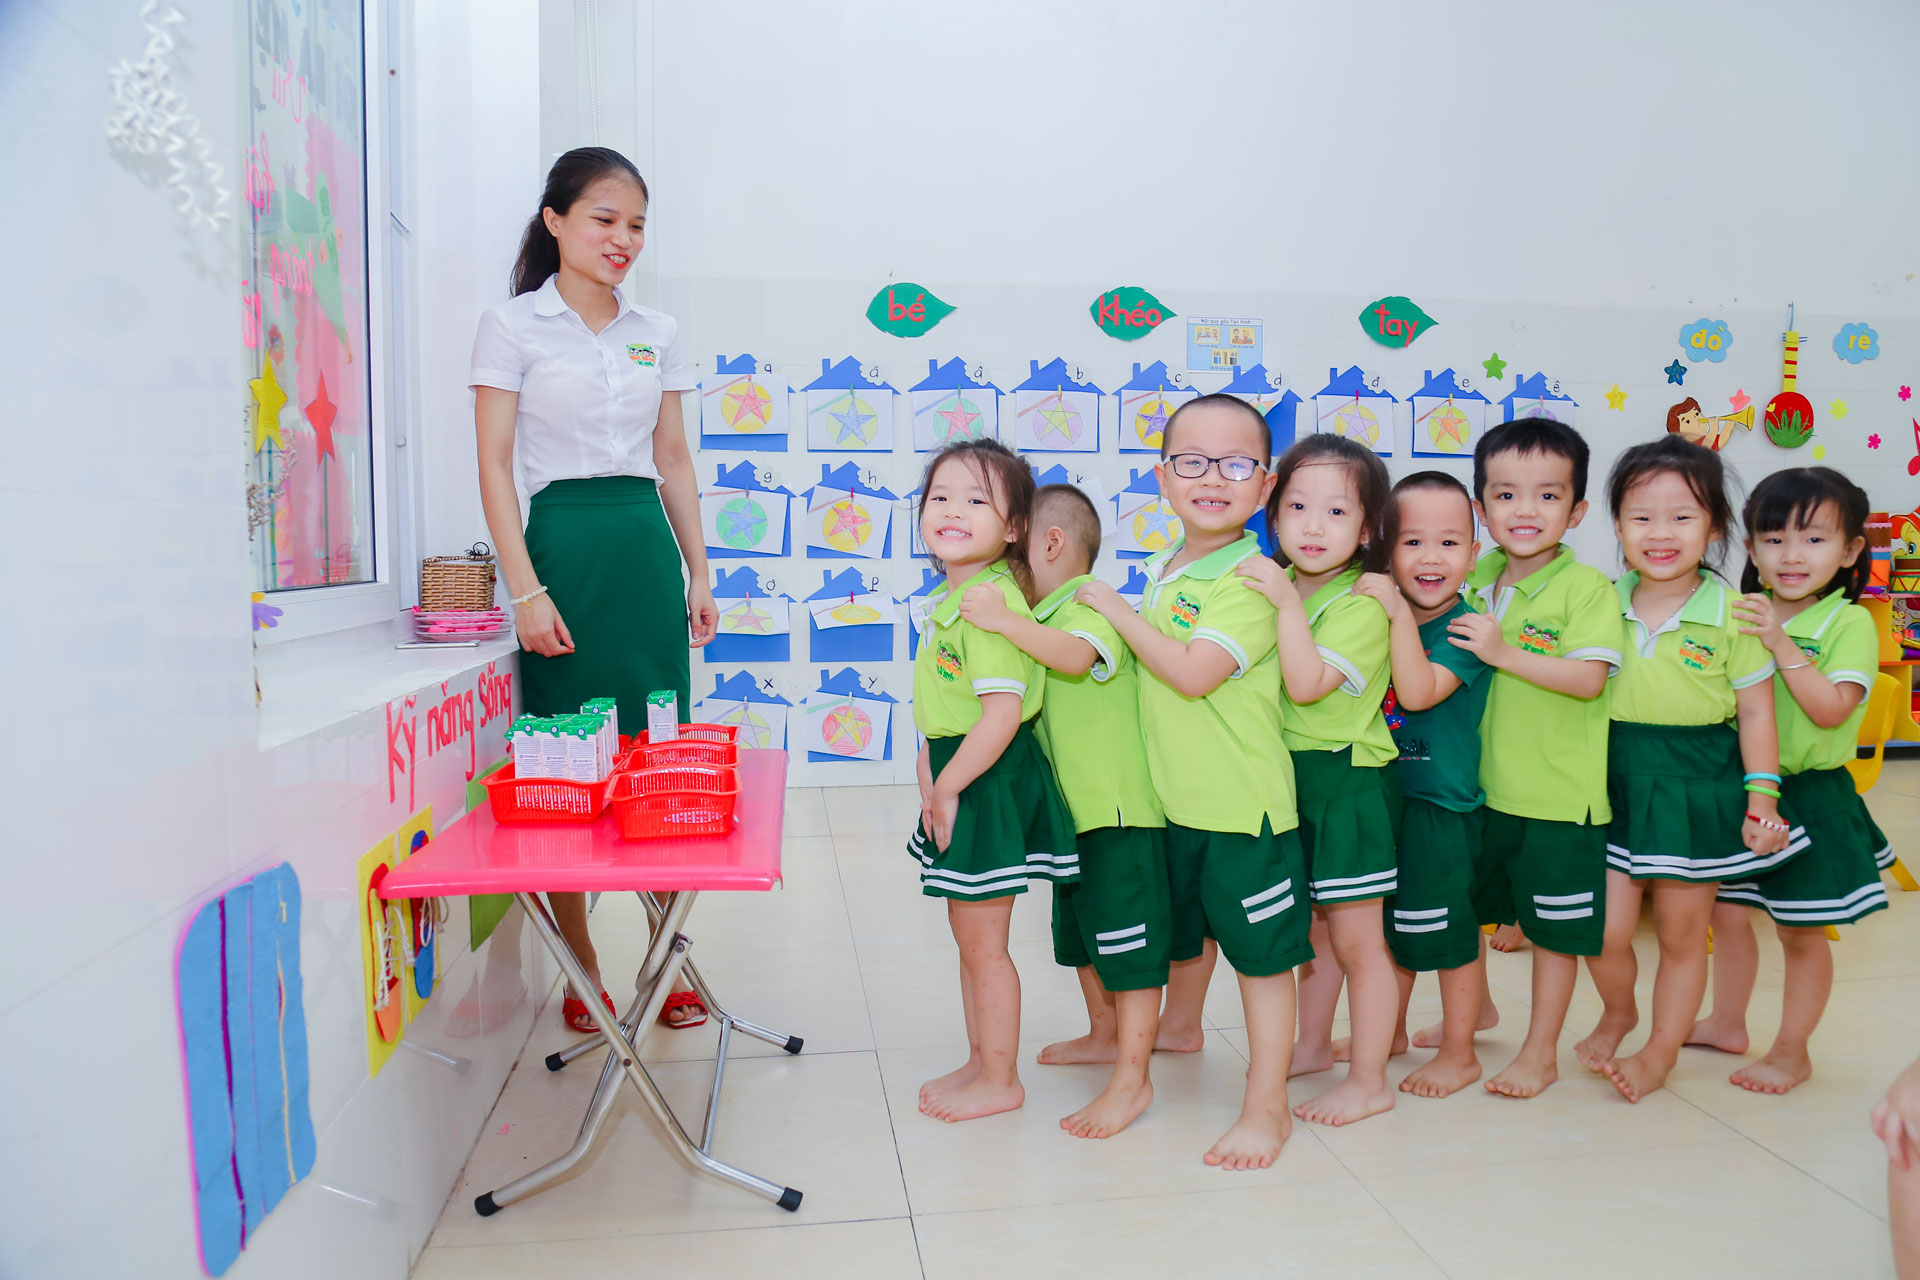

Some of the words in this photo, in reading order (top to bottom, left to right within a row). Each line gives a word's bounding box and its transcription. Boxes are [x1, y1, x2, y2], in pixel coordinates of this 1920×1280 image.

[888, 289, 926, 322] bé
[1373, 303, 1419, 348] tay
[1076, 366, 1084, 380] b
[1273, 372, 1282, 386] d
[1462, 378, 1470, 388] e
[1553, 380, 1560, 393] ê
[868, 470, 876, 485] h
[427, 680, 476, 781] năng
